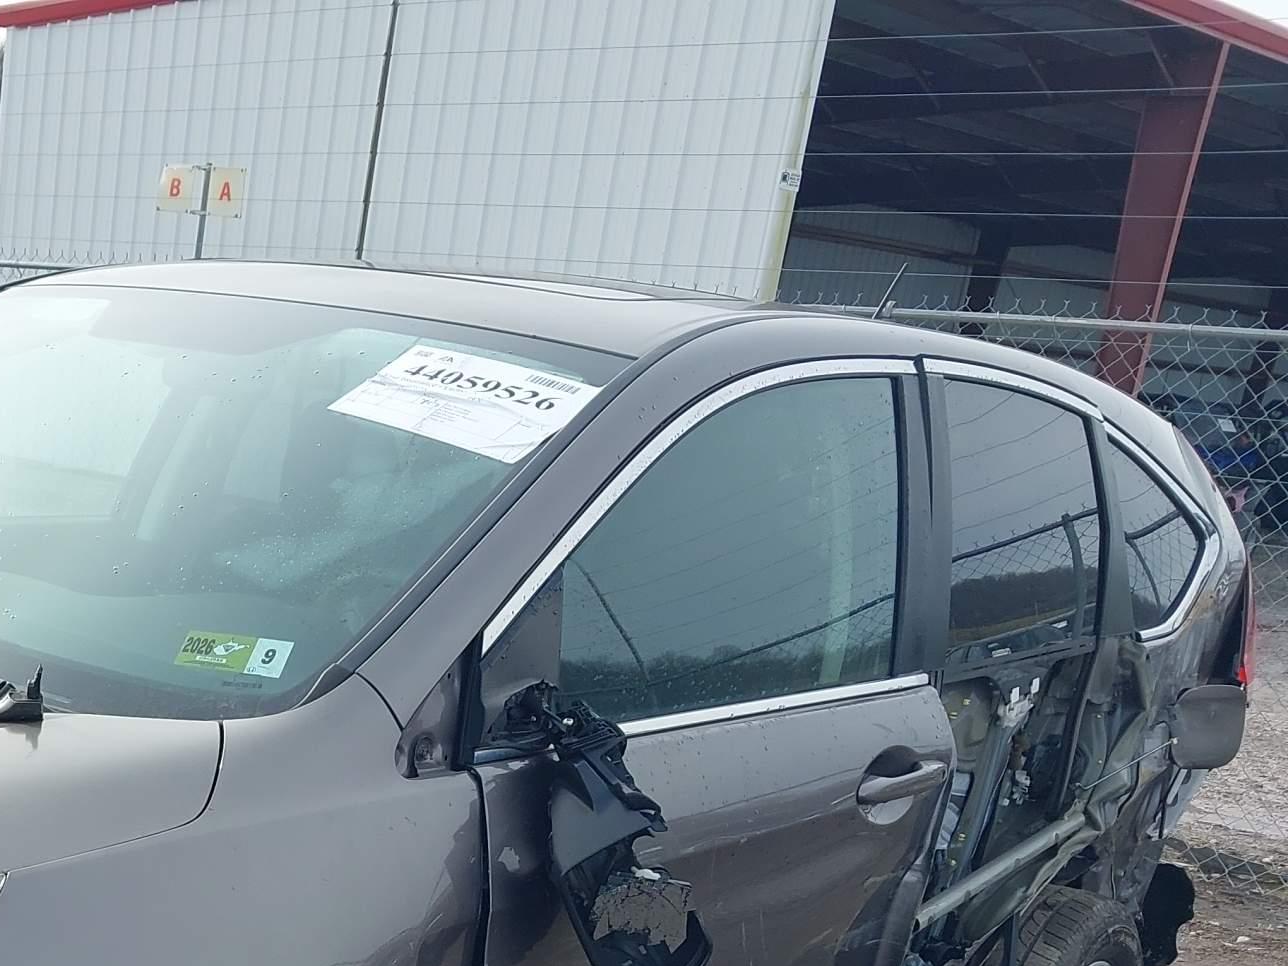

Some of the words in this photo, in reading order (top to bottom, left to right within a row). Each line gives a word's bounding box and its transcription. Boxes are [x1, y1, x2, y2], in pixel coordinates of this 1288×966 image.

[169, 178, 181, 197] B
[219, 182, 232, 202] A
[404, 364, 561, 411] 44059526
[182, 636, 215, 655] 2026
[260, 648, 277, 665] 9
